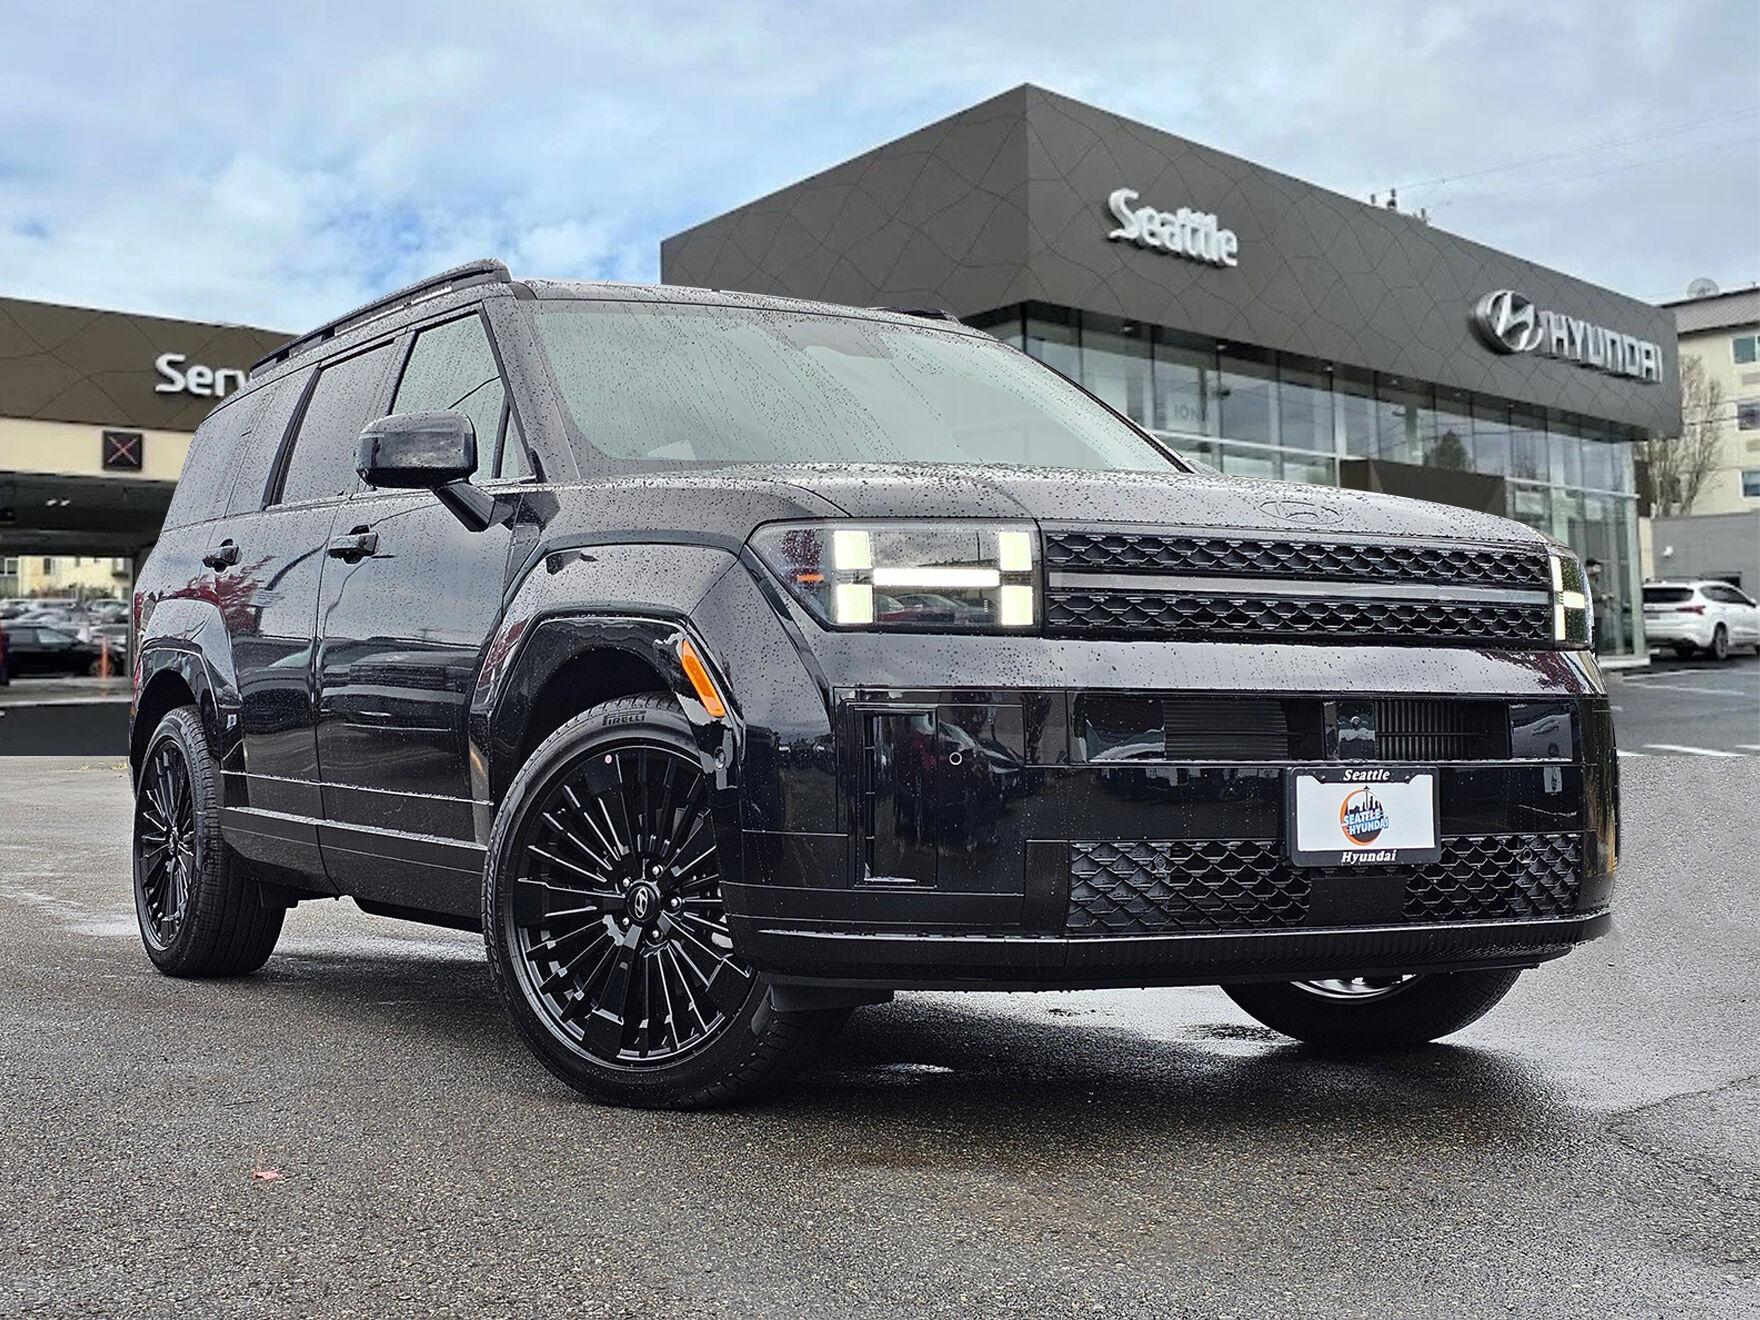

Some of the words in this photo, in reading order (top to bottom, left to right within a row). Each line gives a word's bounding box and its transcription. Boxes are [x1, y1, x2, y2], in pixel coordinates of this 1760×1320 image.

[1108, 188, 1238, 266] Seattle
[1543, 311, 1663, 383] HYUNDAI
[602, 709, 647, 727] PIRELLI
[1343, 769, 1390, 781] Seattle
[1343, 809, 1382, 826] SEATTLE
[1349, 816, 1390, 836] HYUNDAI
[1341, 849, 1397, 864] Hyundai
